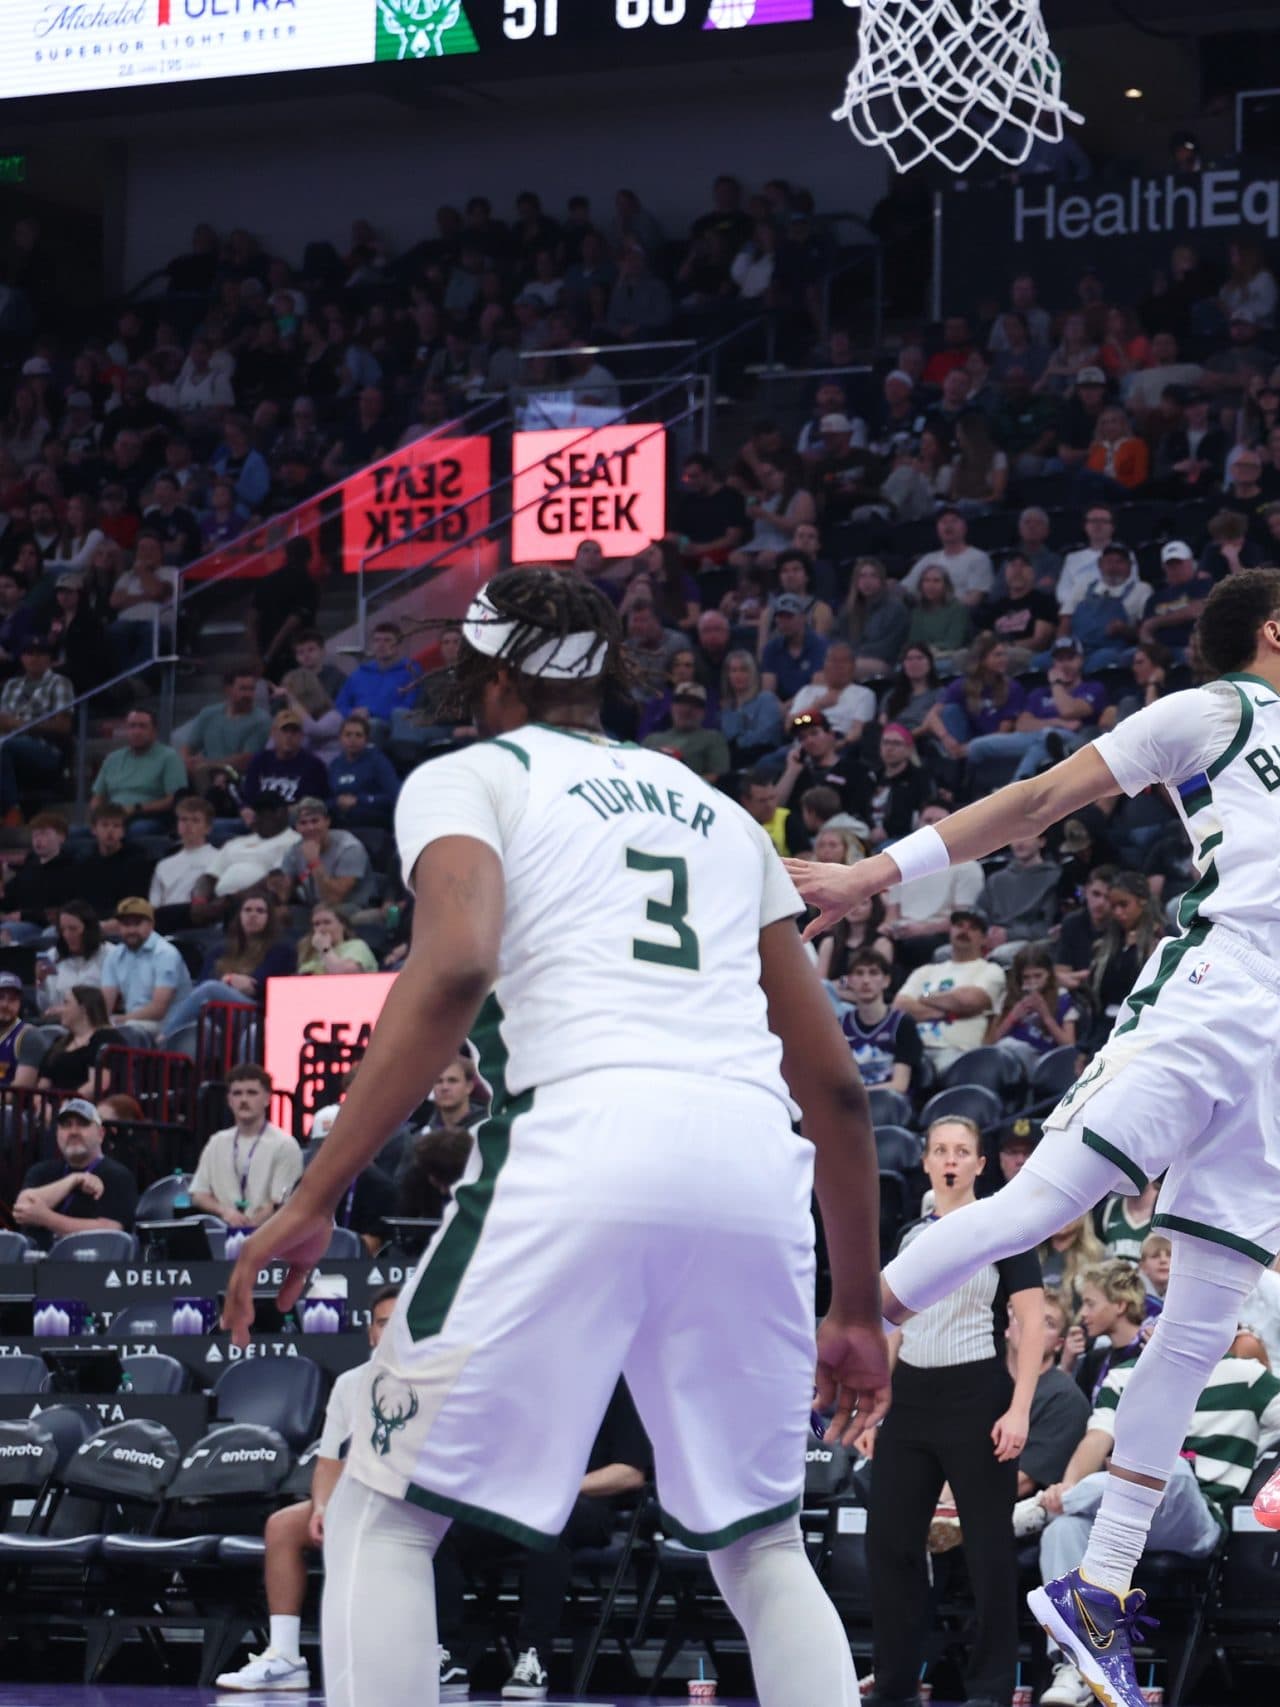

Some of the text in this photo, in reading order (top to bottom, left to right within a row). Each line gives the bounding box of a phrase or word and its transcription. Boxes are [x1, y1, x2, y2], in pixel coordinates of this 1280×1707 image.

[35, 25, 296, 62] SUPERIOR LIGHT BEER
[543, 448, 640, 489] SEAT
[537, 494, 640, 534] GEEK
[567, 777, 716, 838] TURNER
[625, 846, 701, 972] 3
[126, 1269, 192, 1286] DELTA
[0, 1443, 43, 1457] ntrata
[113, 1446, 165, 1469] entrata
[221, 1448, 277, 1463] entrata
